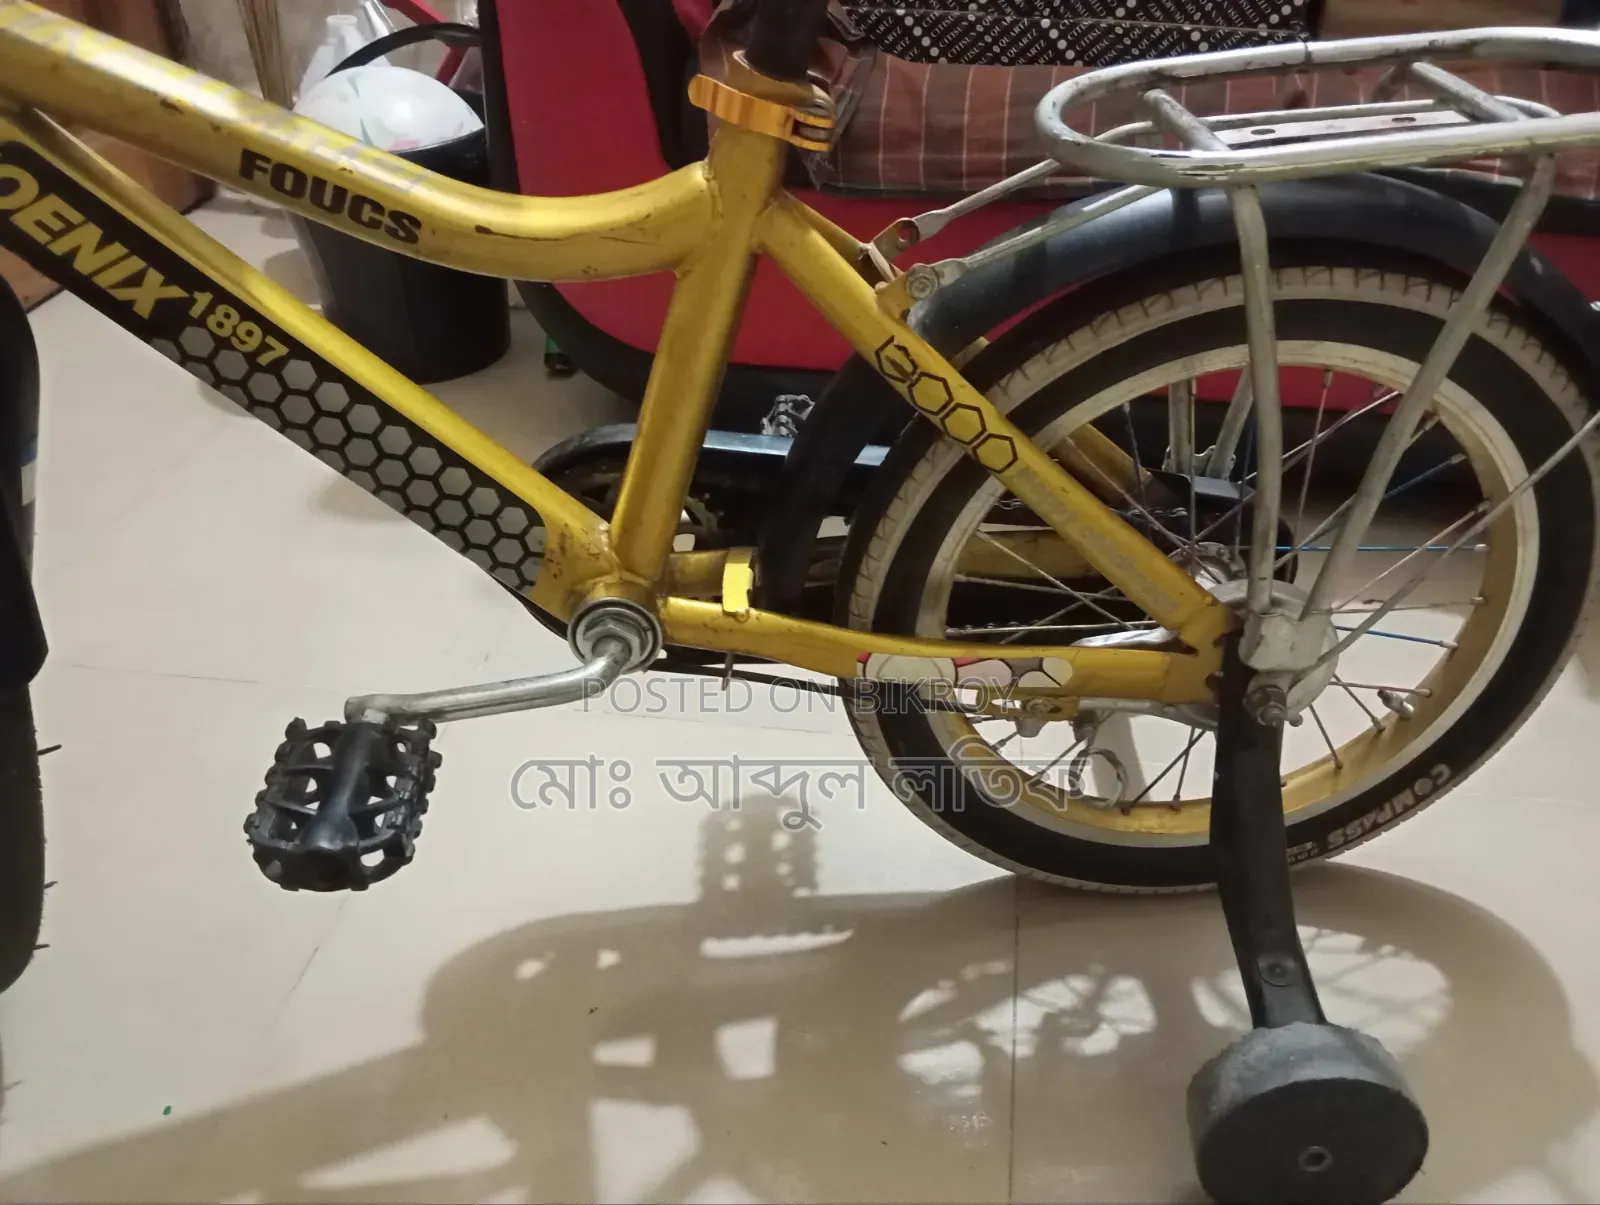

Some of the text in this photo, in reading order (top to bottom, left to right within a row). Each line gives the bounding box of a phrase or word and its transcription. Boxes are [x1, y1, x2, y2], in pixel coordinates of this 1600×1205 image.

[1006, 28, 1038, 58] QUARTZ
[238, 147, 422, 245] FOUCS
[189, 291, 290, 367] 1897
[1326, 763, 1451, 850] COMPASS
